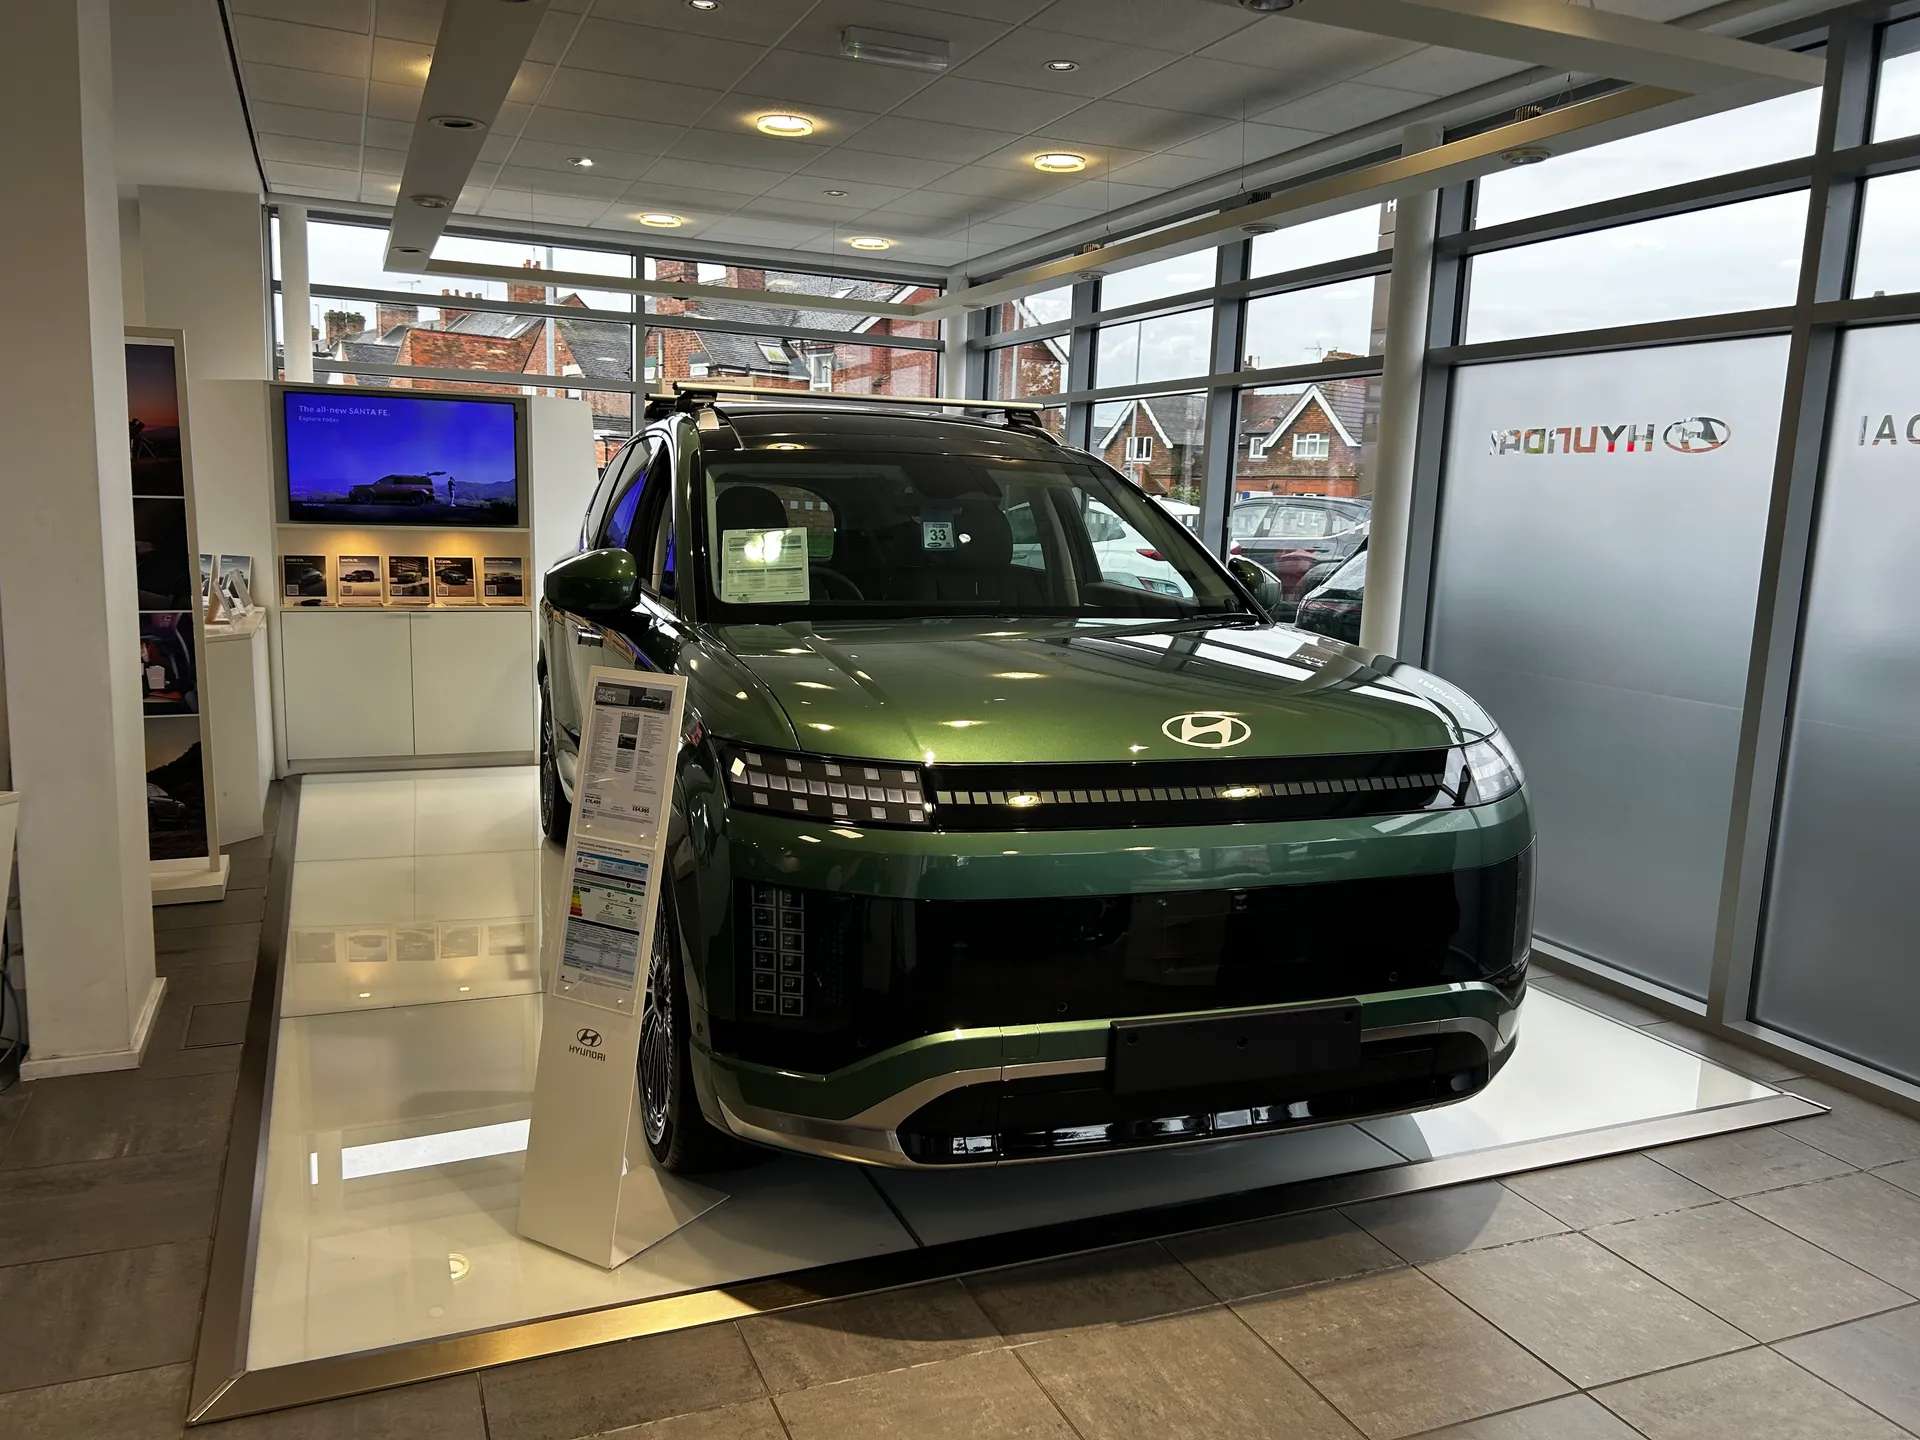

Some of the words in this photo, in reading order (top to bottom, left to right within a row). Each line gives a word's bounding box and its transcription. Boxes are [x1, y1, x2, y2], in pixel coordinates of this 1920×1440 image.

[299, 405, 313, 413] The
[316, 405, 347, 415] all-new
[348, 407, 376, 416] SANTA
[929, 529, 947, 541] 33
[568, 1045, 606, 1062] HYUNDAI
